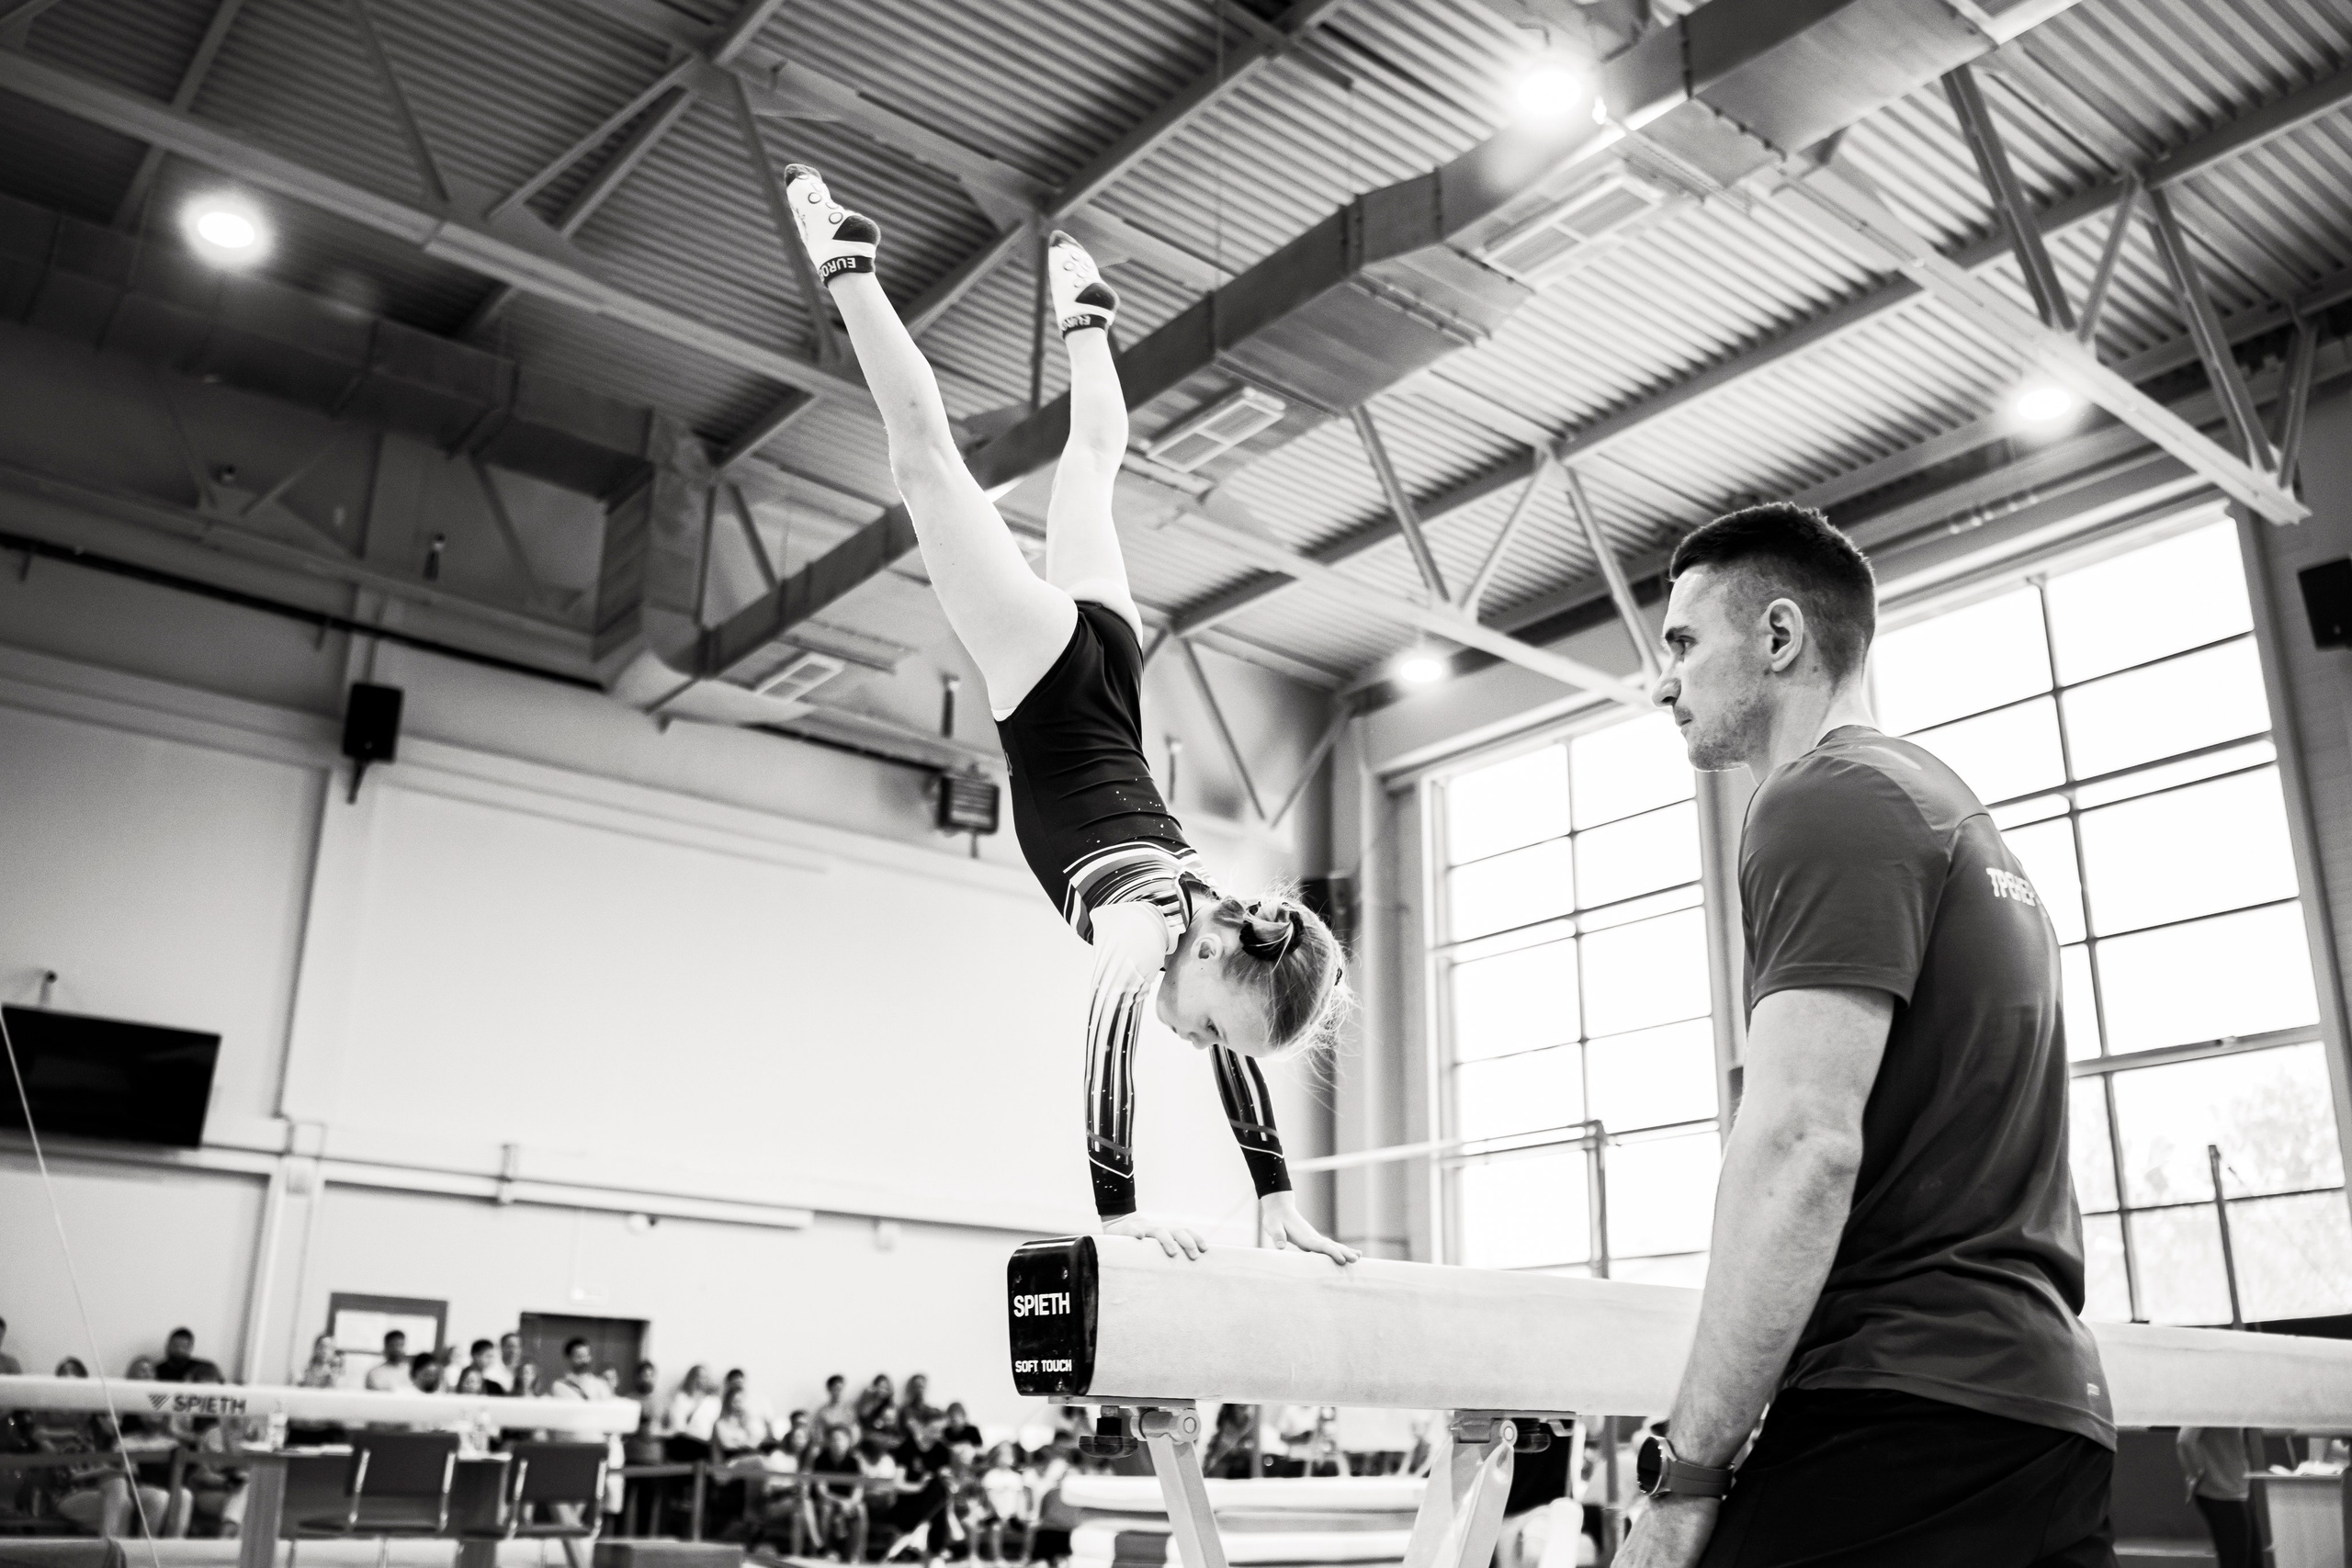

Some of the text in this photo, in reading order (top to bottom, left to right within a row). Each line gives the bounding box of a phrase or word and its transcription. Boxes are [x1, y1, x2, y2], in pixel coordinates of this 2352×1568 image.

[1013, 1292, 1070, 1317] SPIETH
[1015, 1359, 1072, 1373] SOFT TOUCH
[173, 1393, 247, 1414] SPIETH
